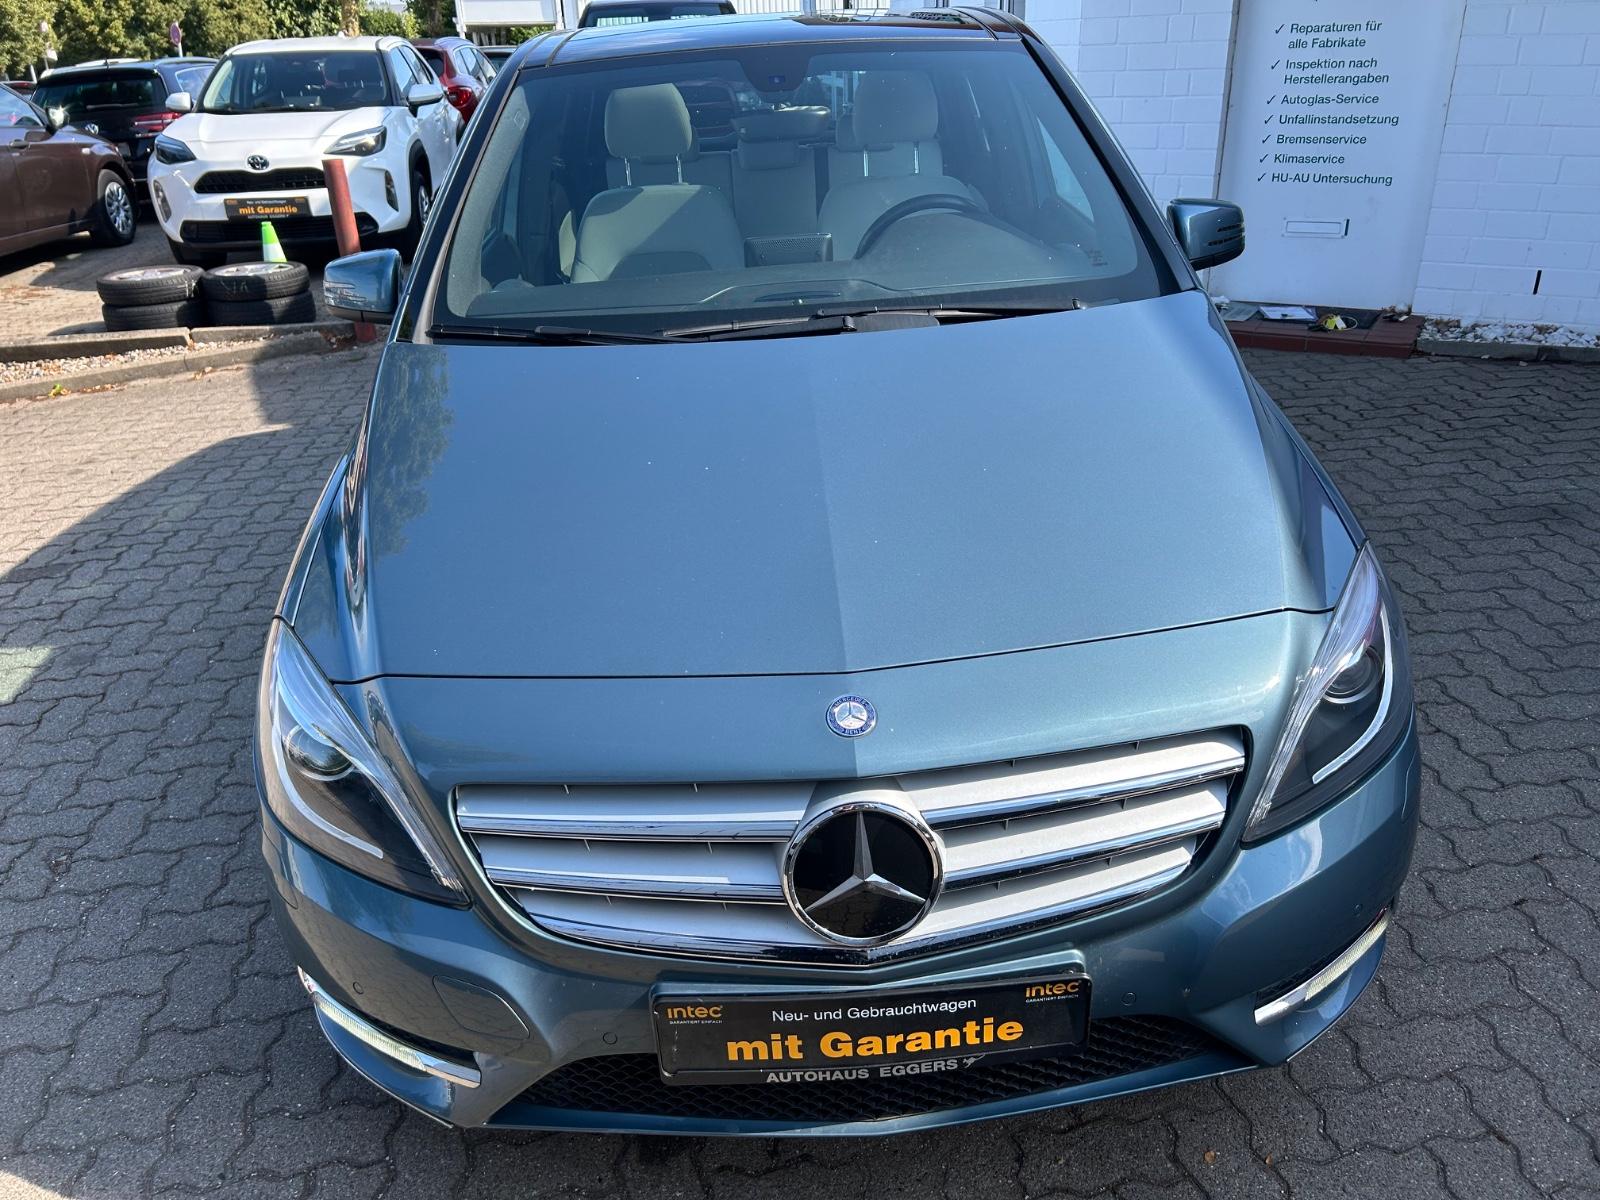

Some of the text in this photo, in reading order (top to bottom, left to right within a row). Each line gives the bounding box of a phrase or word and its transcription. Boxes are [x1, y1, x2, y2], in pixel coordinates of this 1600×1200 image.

[1290, 20, 1382, 35] Reparaturen für
[1288, 37, 1366, 49] alle Fabrikate
[1285, 57, 1378, 71] Inspektion nach
[1284, 73, 1389, 86] Herstellerangaben
[1281, 94, 1380, 107] Autoglas-Service
[1279, 114, 1400, 126] Unfallinstandsetzung
[1276, 134, 1367, 145] Bremsenservice
[1273, 153, 1345, 164] Klimaservice
[1271, 172, 1393, 187] HU-AU Untersuchung
[239, 206, 255, 214] mit
[1025, 981, 1080, 998] intec
[667, 1005, 722, 1019] intec
[772, 999, 977, 1022] Neu- und Gebrauchtwagen
[726, 1016, 1024, 1061] mit Garantie
[766, 1059, 959, 1083] AUTOHAUS EGGERS
